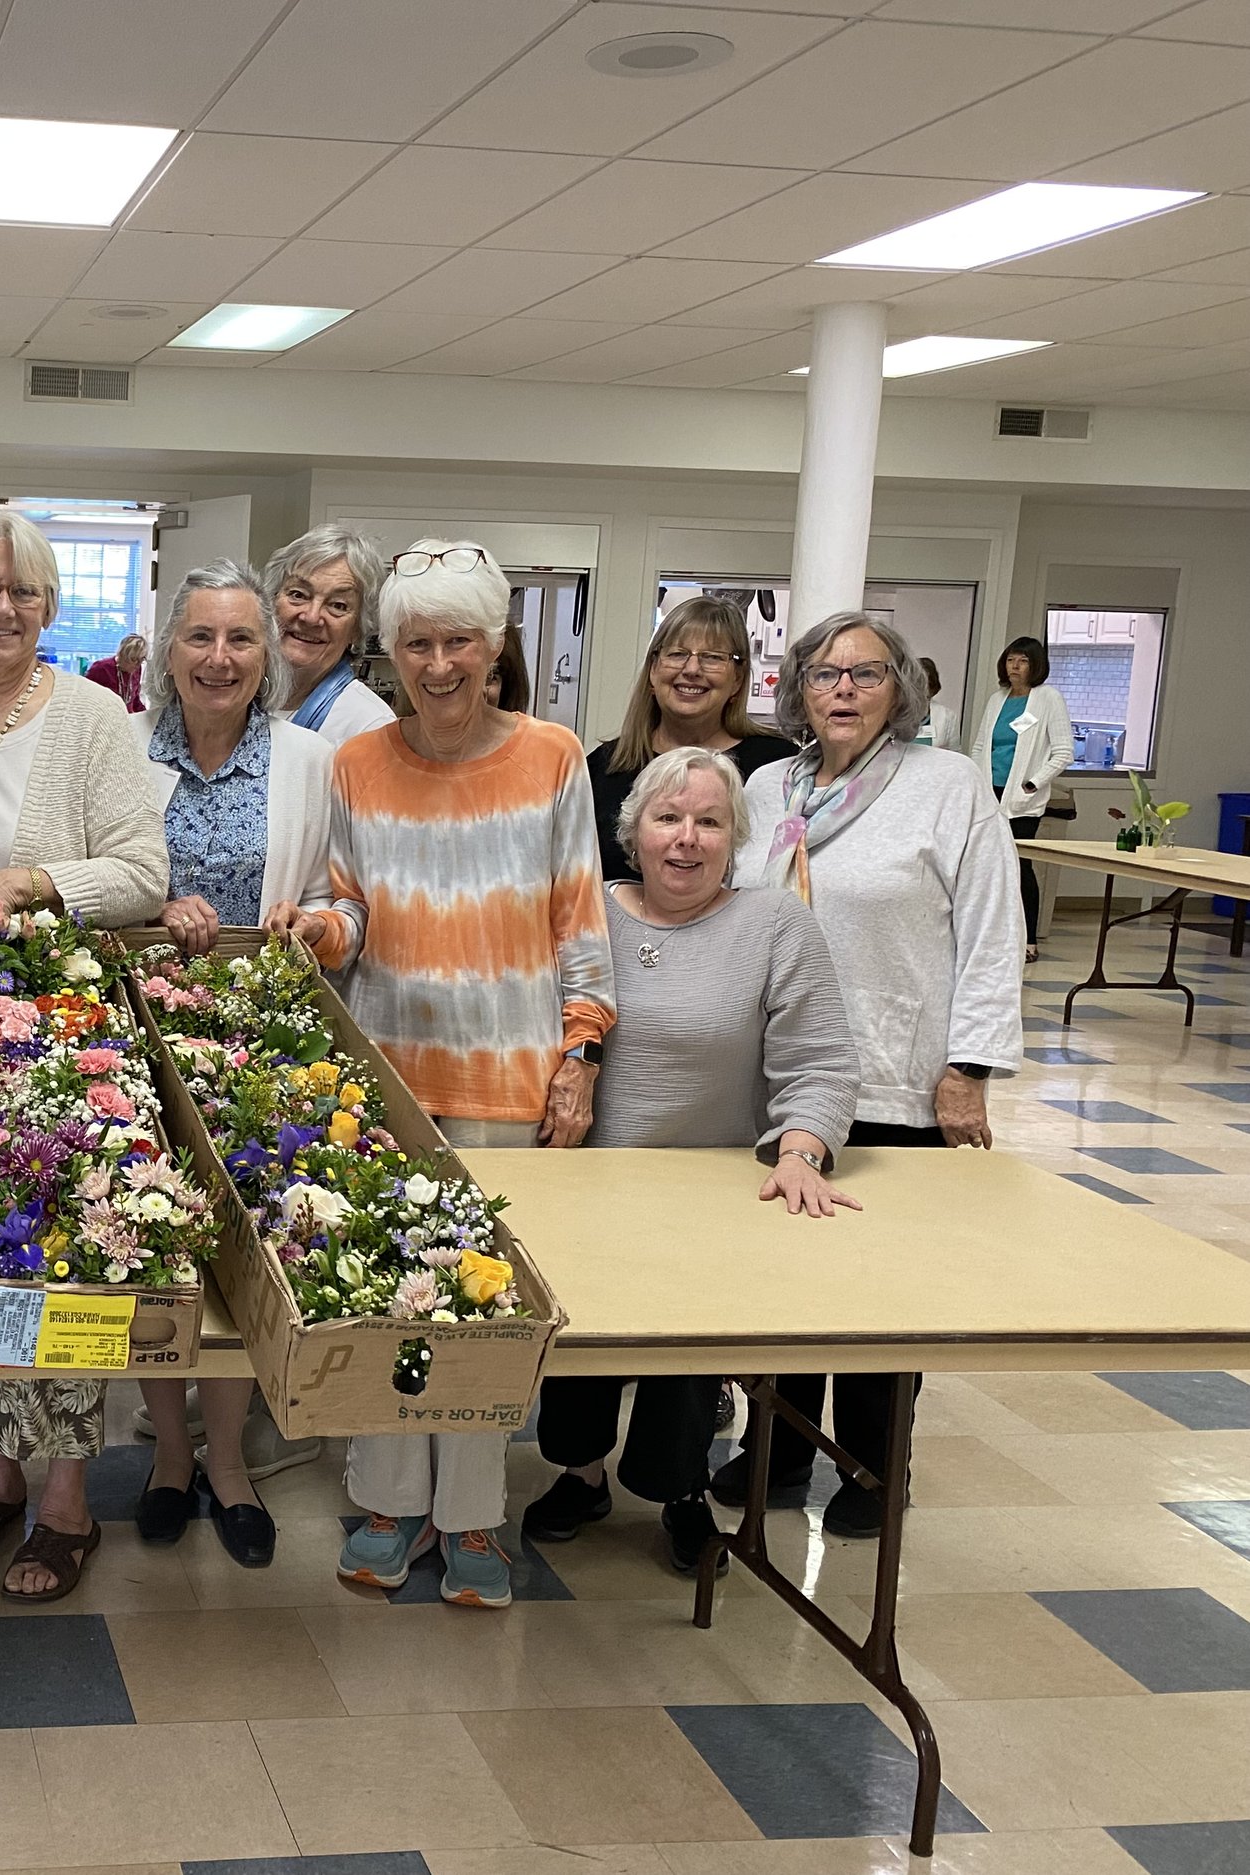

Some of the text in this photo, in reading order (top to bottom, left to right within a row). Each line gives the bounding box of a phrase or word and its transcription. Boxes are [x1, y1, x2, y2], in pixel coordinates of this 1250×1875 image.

[468, 1331, 533, 1341] COMPLETE
[135, 1351, 179, 1363] QB-P
[448, 1409, 522, 1421] DAFLOR
